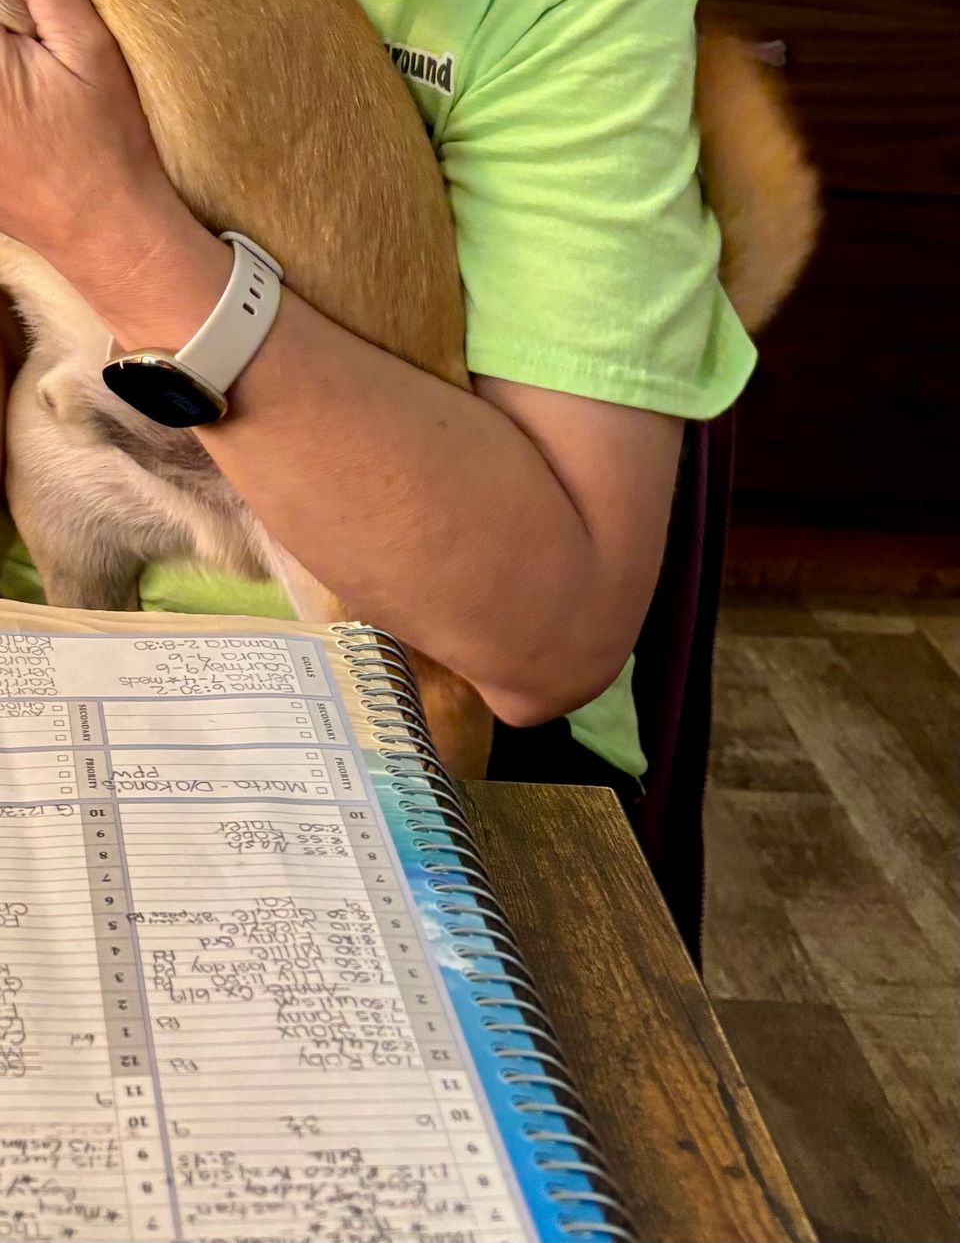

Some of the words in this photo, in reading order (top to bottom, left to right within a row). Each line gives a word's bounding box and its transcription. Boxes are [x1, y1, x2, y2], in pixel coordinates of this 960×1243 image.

[384, 43, 453, 92] round
[204, 639, 278, 651] Tamara
[221, 652, 285, 662] Laura
[202, 661, 292, 673] Courtney
[301, 656, 315, 677] GOALS
[226, 673, 295, 684] Jerika
[230, 683, 295, 694] Emma
[79, 704, 91, 741] SECONDARY
[318, 702, 336, 741] SECONDARY
[86, 758, 97, 790] PRIORITY
[335, 757, 353, 791] PRIORITY
[235, 780, 307, 793] Marta
[90, 809, 105, 817] 10
[350, 811, 365, 820] 10
[96, 830, 105, 838] 9
[228, 841, 289, 854] Nash
[368, 852, 377, 860] 8
[102, 874, 111, 882] 7
[376, 875, 385, 883] 7
[105, 897, 114, 905] 6
[382, 896, 392, 905] 6
[108, 921, 118, 930] 5
[219, 919, 315, 934] Weezie
[392, 919, 400, 929] 5
[111, 946, 120, 956] 4
[399, 944, 408, 952] 4
[115, 972, 125, 982] 3
[408, 969, 418, 978] 3
[118, 999, 127, 1010] 2
[416, 995, 427, 1005] 2
[123, 1027, 130, 1036] 1
[428, 1022, 435, 1032] 1
[298, 1046, 363, 1072] Ruby
[430, 1050, 450, 1060] 12
[120, 1056, 140, 1066] 12
[441, 1079, 461, 1091] 11
[126, 1086, 143, 1096] 11
[451, 1109, 471, 1120] 10
[128, 1117, 146, 1127] 10
[138, 1150, 149, 1160] 9
[142, 1182, 152, 1193] 8
[147, 1218, 157, 1231] 7
